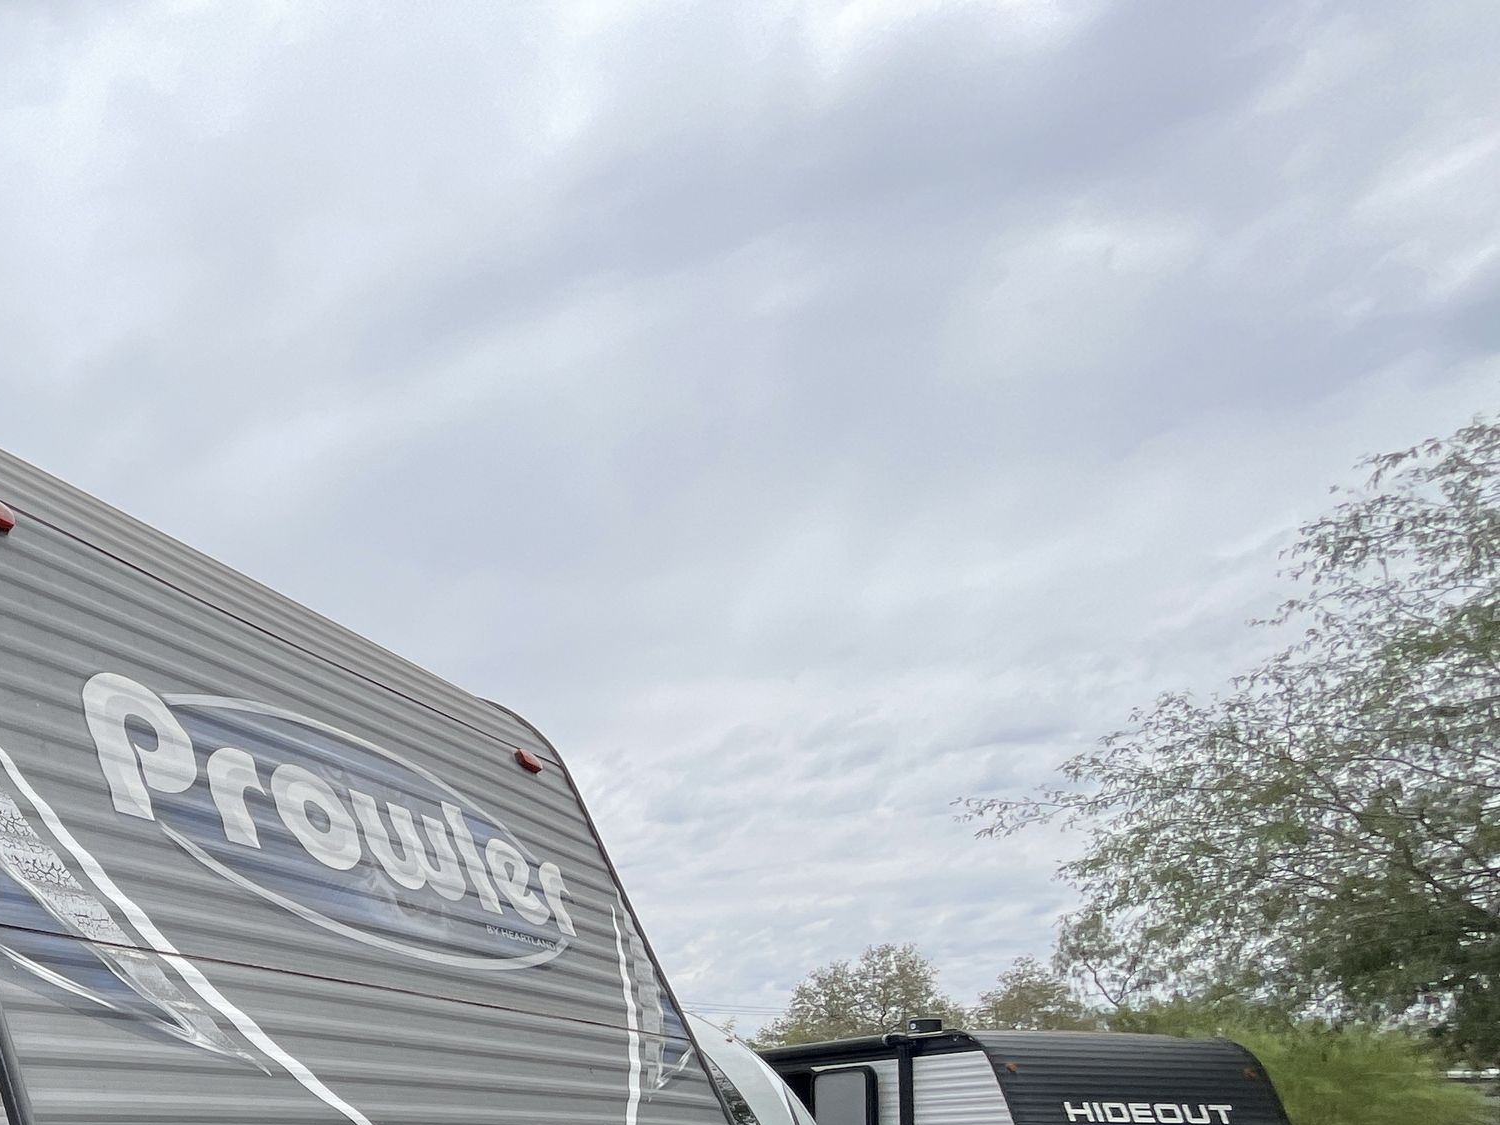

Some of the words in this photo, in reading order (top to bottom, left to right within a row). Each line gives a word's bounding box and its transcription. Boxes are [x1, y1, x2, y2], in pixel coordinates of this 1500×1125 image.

[82, 672, 577, 937] Prowler
[485, 925, 500, 935] BY
[500, 929, 556, 951] HEARTLAND
[1063, 1101, 1233, 1125] HIDEOUT
